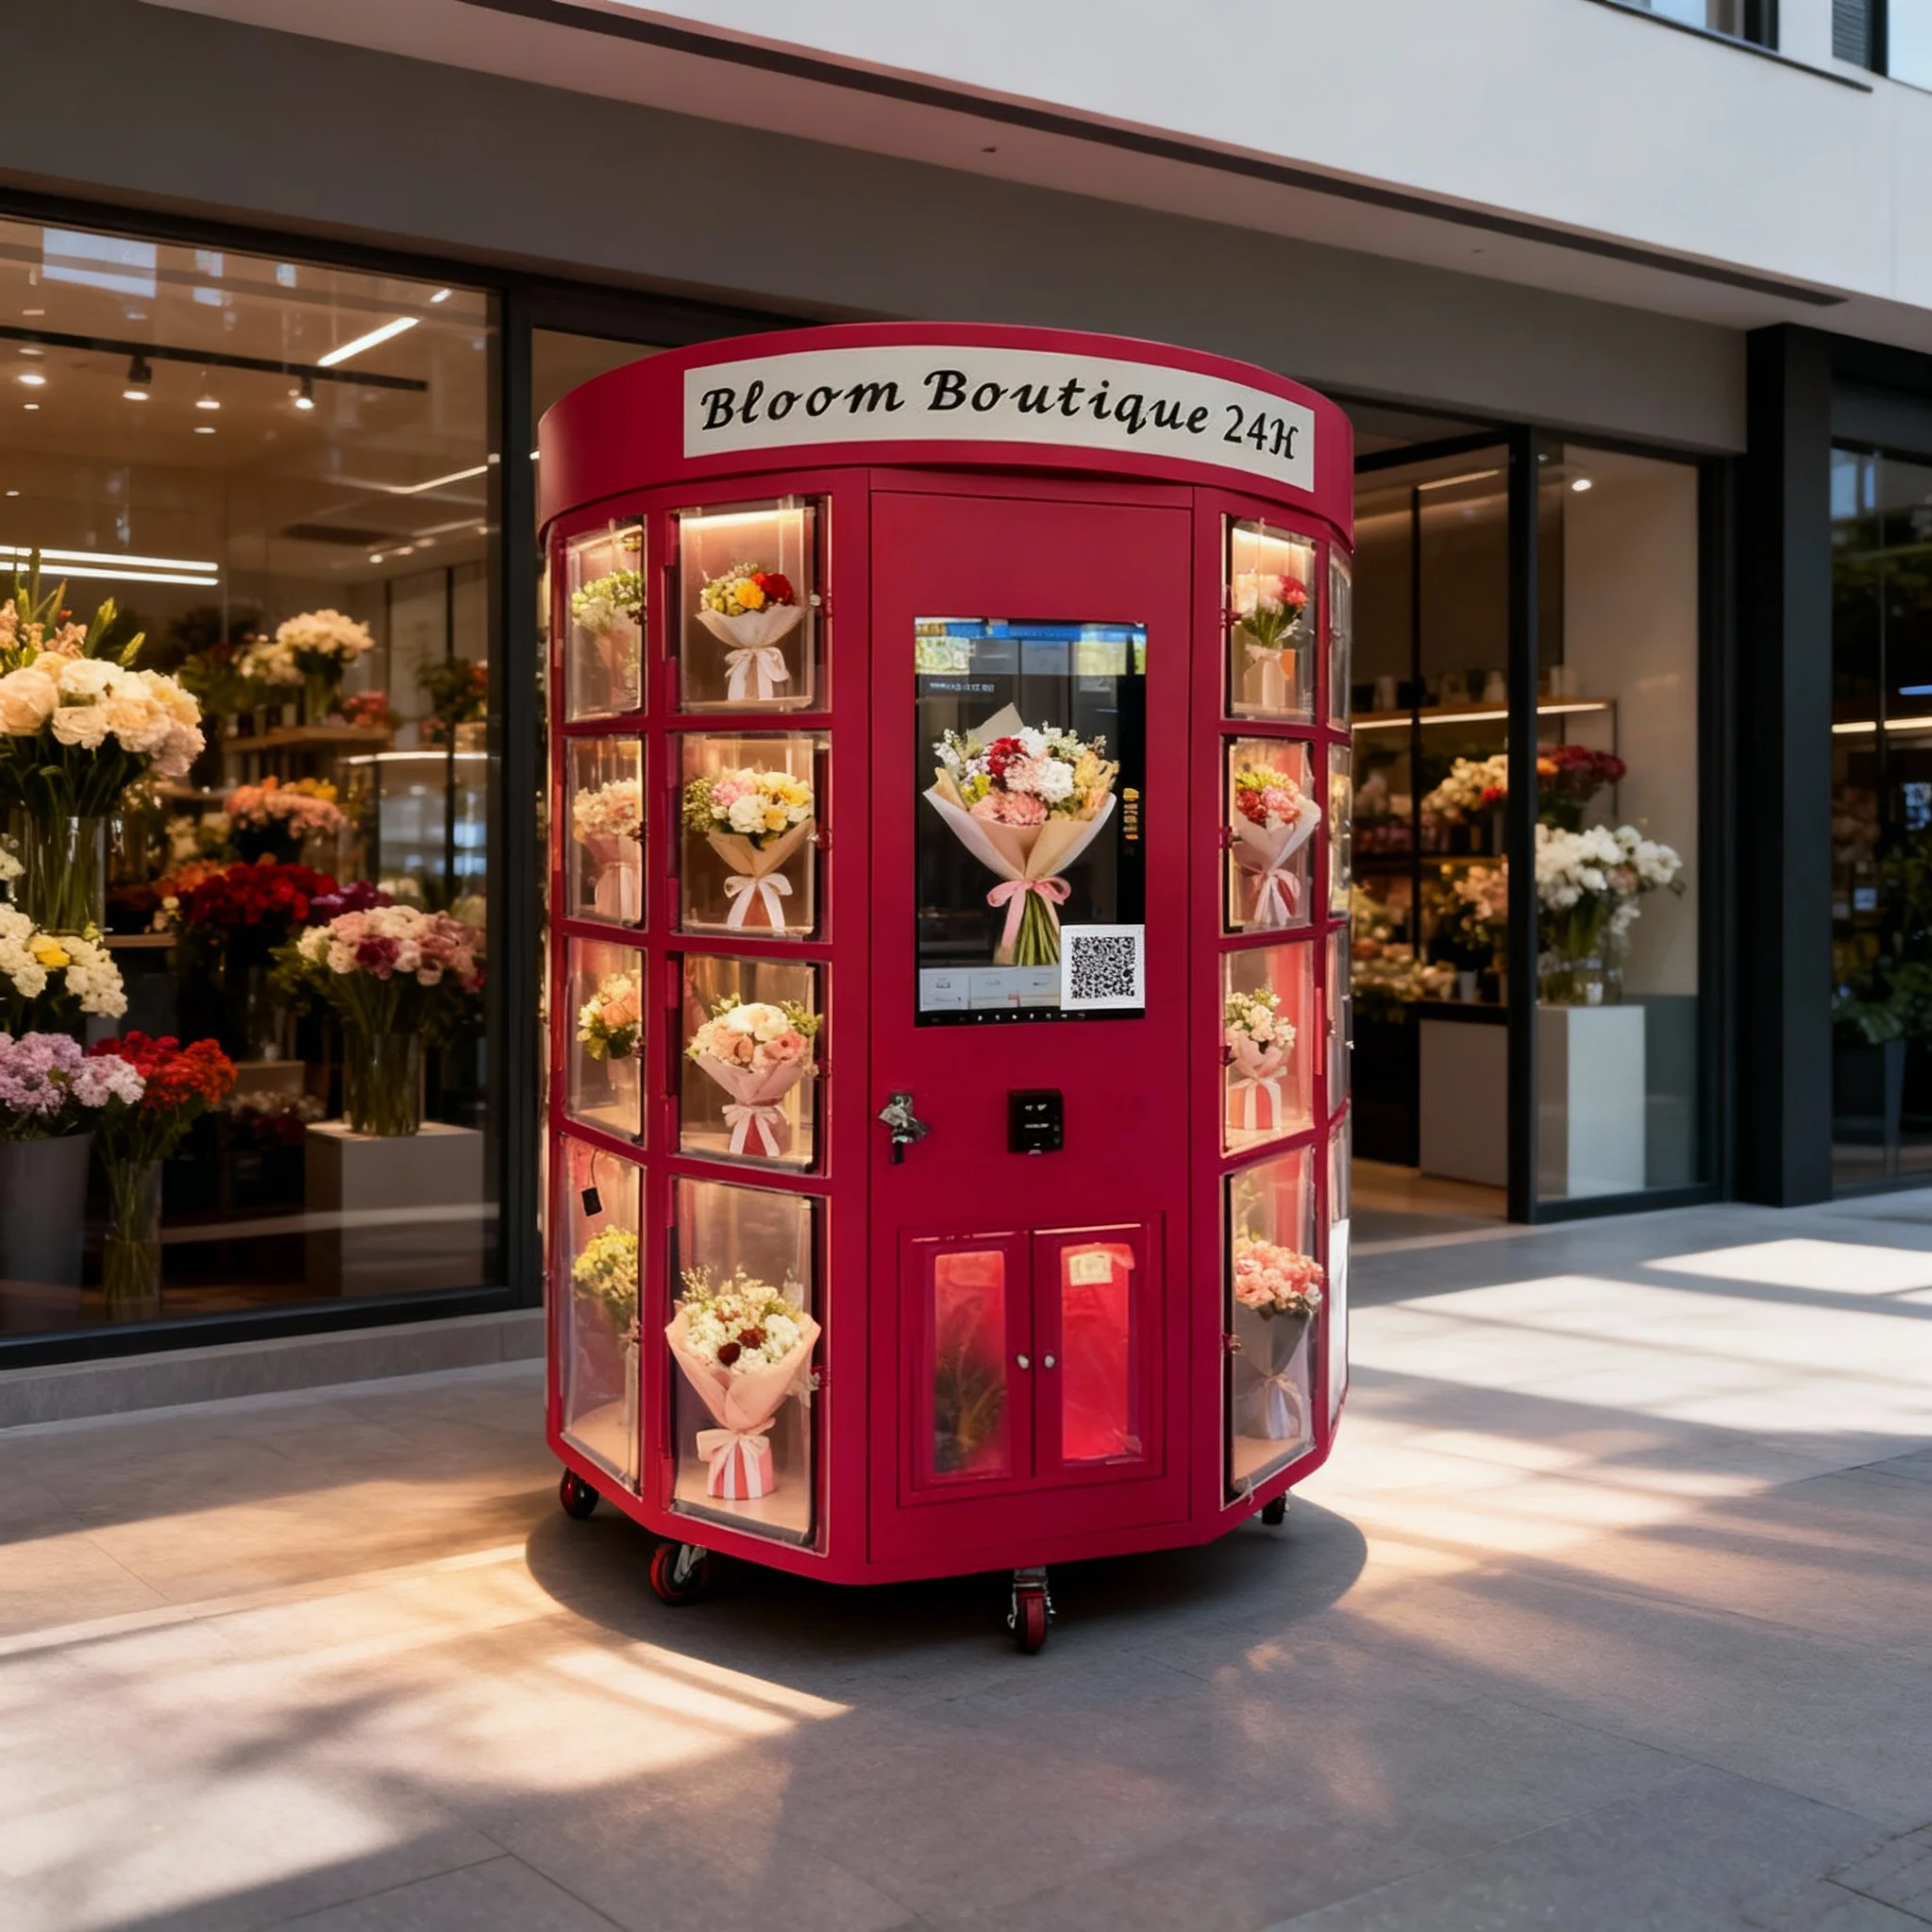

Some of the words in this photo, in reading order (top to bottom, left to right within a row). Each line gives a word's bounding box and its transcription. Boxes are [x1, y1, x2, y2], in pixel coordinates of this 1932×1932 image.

[700, 380, 905, 431] Bloom
[923, 369, 1209, 435] Boutique
[1223, 404, 1300, 461] 24H
